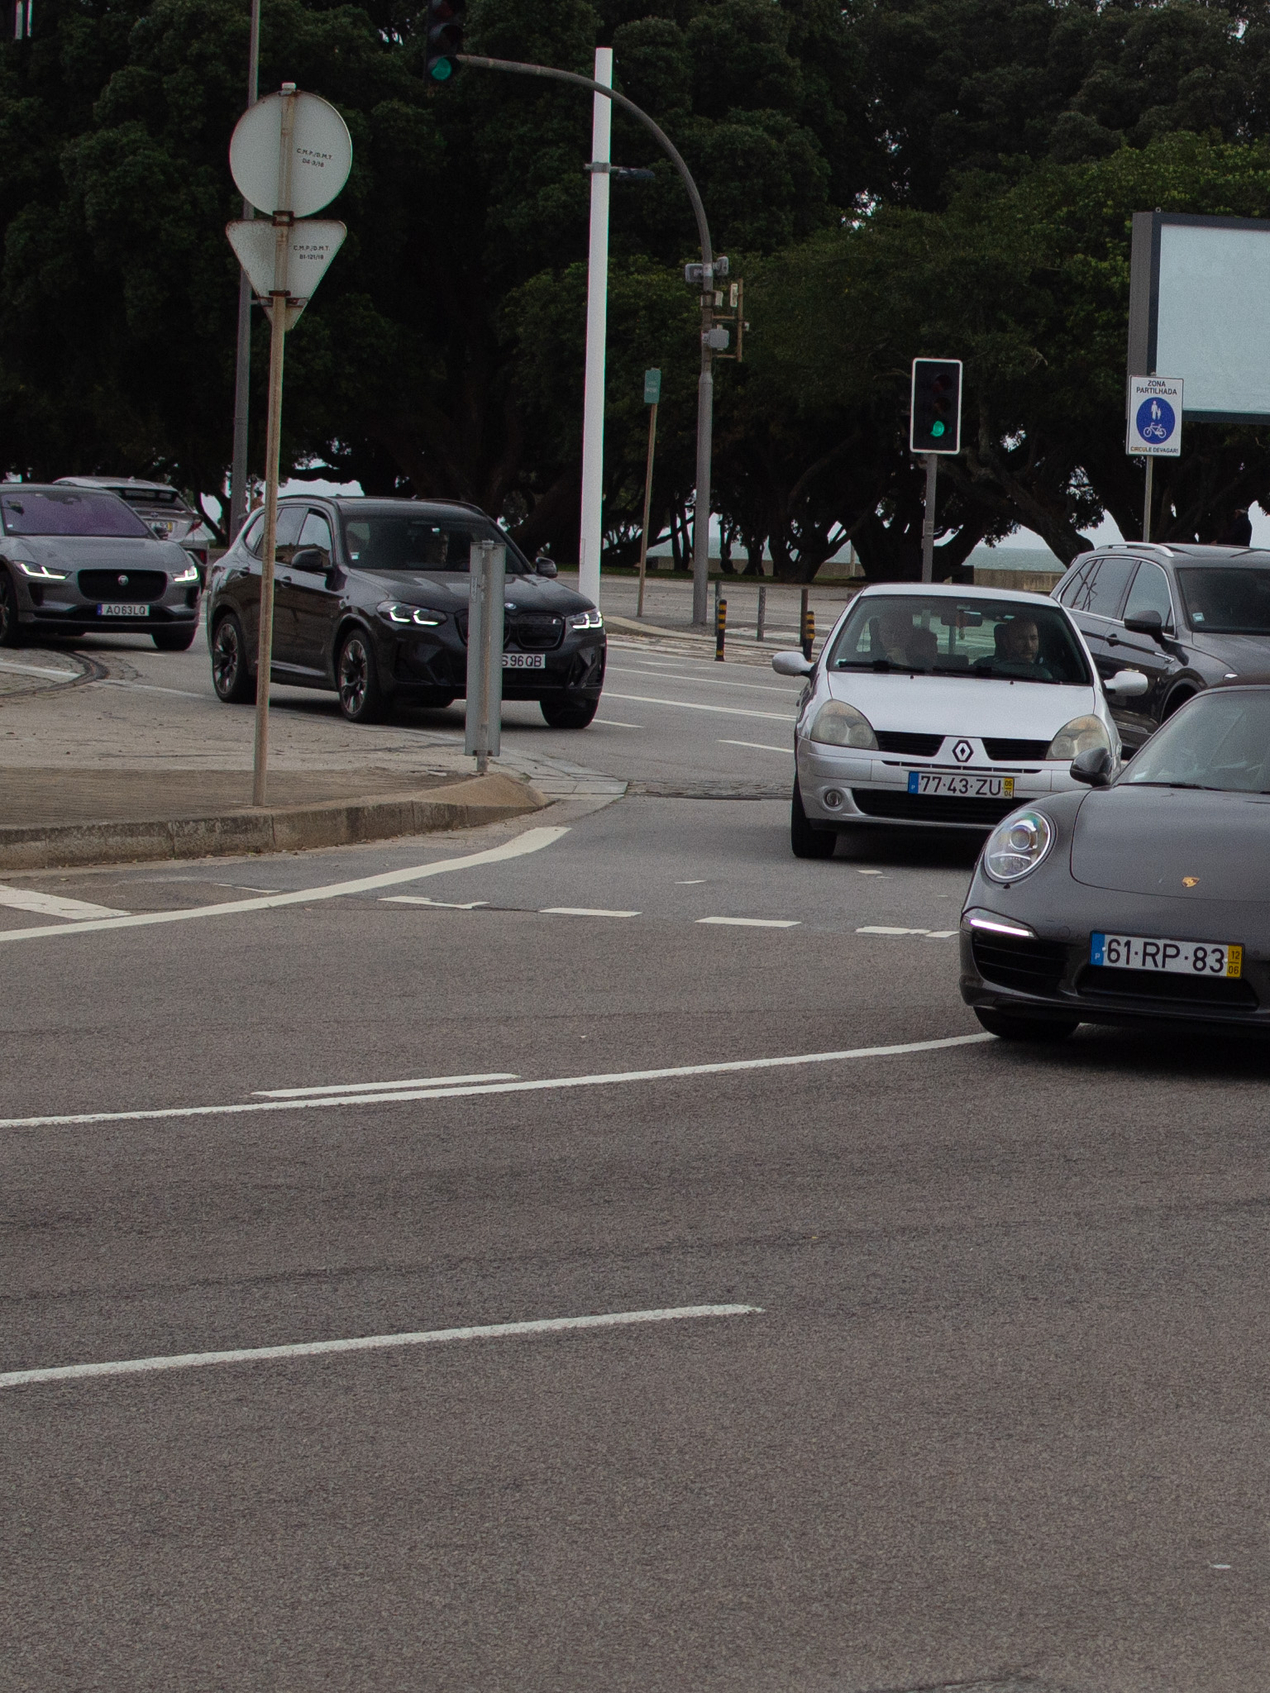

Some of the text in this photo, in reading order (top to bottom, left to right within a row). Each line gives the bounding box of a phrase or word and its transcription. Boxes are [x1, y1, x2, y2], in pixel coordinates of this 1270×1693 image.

[1136, 386, 1177, 395] PARTILHADA
[1231, 950, 1240, 961] 12
[1228, 966, 1239, 975] 06
